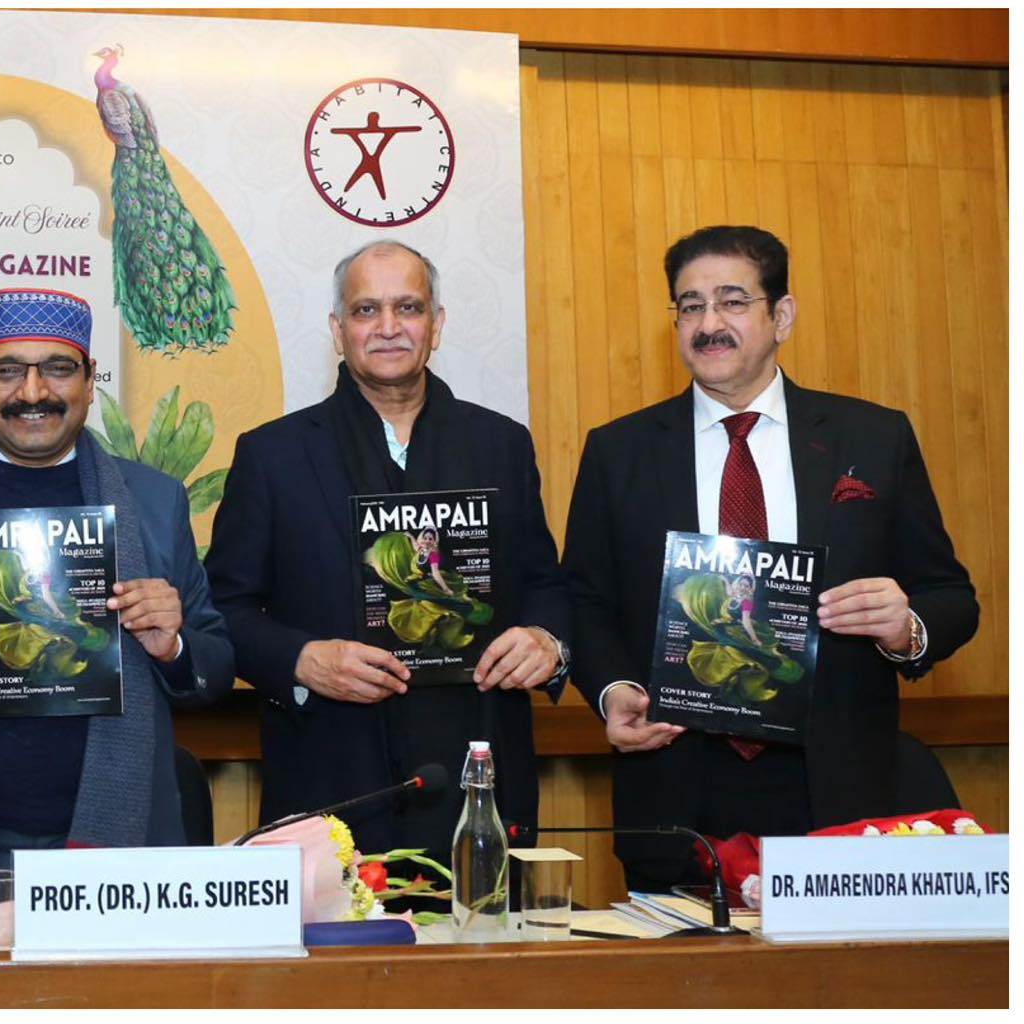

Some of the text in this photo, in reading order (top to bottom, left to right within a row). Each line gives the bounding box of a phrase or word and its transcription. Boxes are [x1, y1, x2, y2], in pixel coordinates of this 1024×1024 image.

[361, 501, 488, 532] AMRAPALI
[59, 547, 104, 558] Magazine
[675, 544, 814, 582] AMRAPALI
[31, 879, 288, 914] PROF. (DR.) K.G. SURESH
[772, 871, 1009, 898] DR. AMARENDRA KHATUA, IFS
